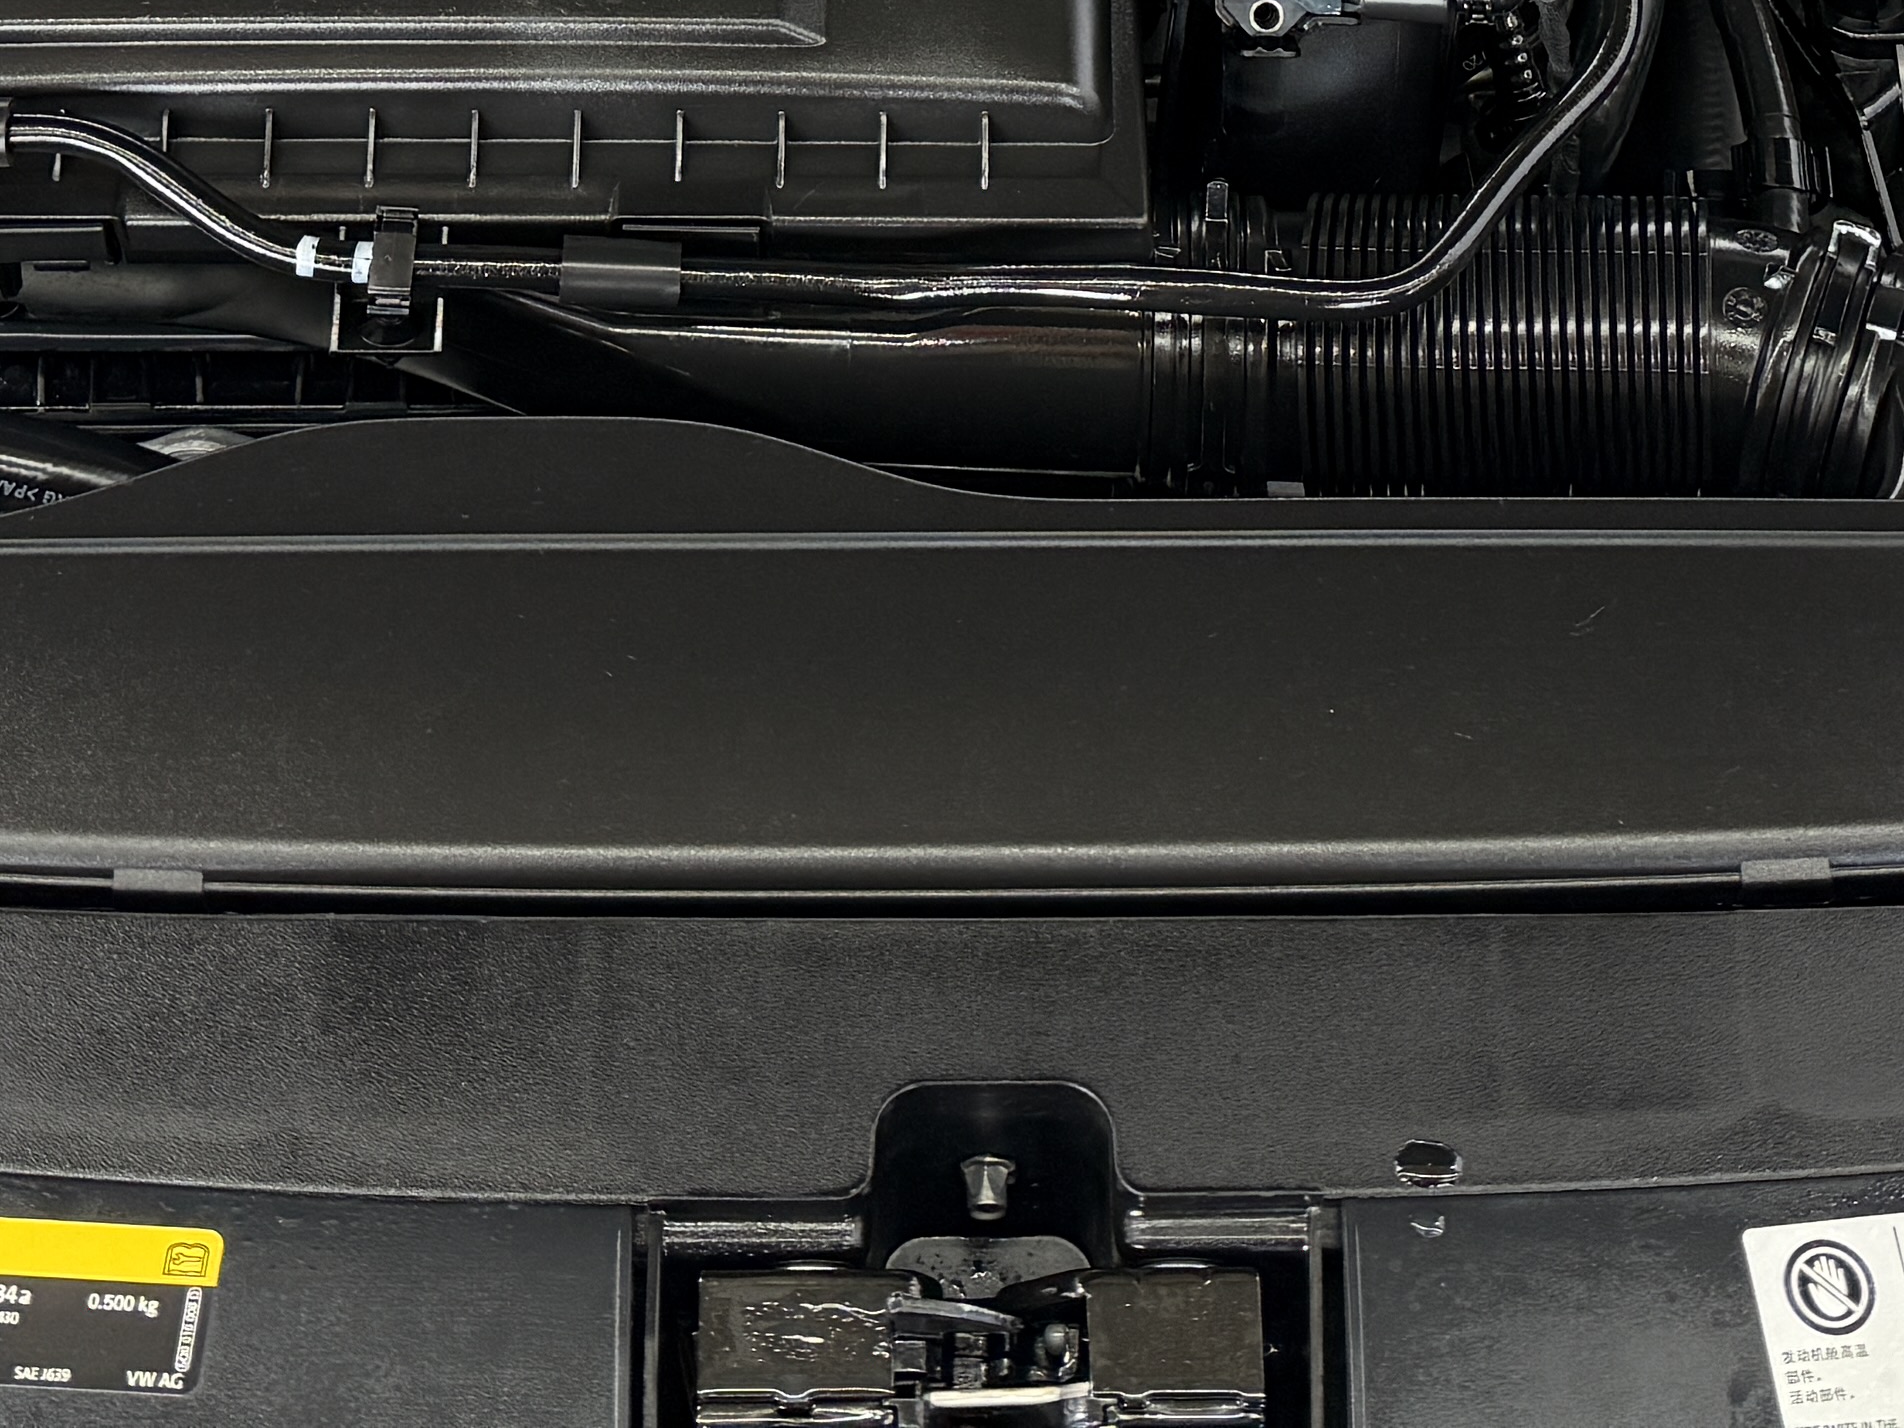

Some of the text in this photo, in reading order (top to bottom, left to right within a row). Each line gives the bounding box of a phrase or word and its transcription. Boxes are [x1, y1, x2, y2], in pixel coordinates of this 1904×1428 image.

[88, 1293, 136, 1312] 0.500
[137, 1296, 160, 1318] kg
[14, 1366, 38, 1381] SAE
[126, 1370, 184, 1390] VW AG
